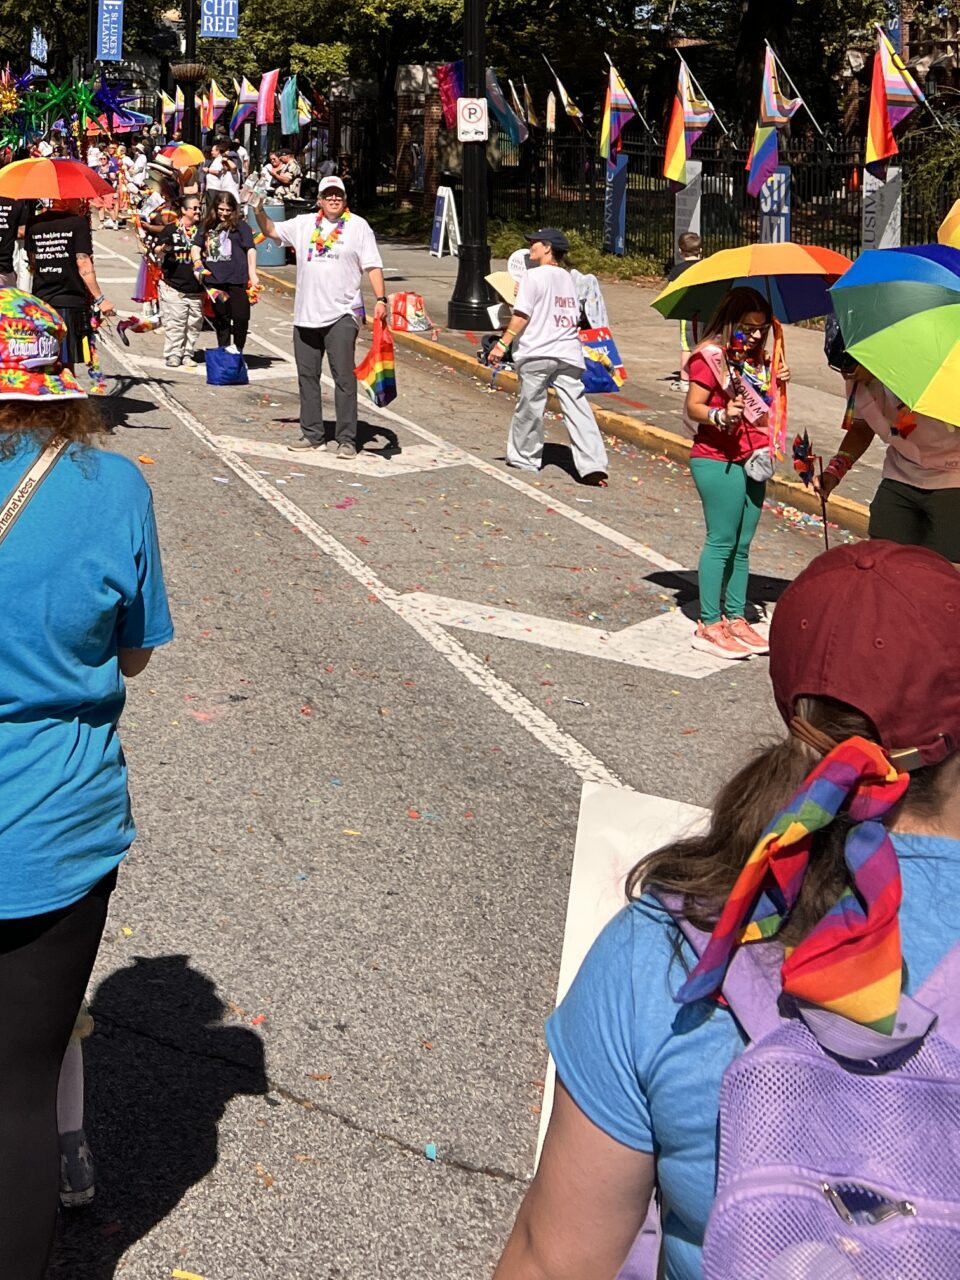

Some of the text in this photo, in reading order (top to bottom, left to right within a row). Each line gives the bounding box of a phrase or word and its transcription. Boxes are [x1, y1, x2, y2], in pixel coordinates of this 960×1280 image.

[203, 0, 237, 16] CHT
[102, 12, 110, 54] ATLANTA
[203, 16, 235, 33] REE
[468, 108, 477, 119] P
[761, 172, 790, 213] STL
[605, 171, 614, 245] DYNAMIC
[555, 296, 576, 308] POWER
